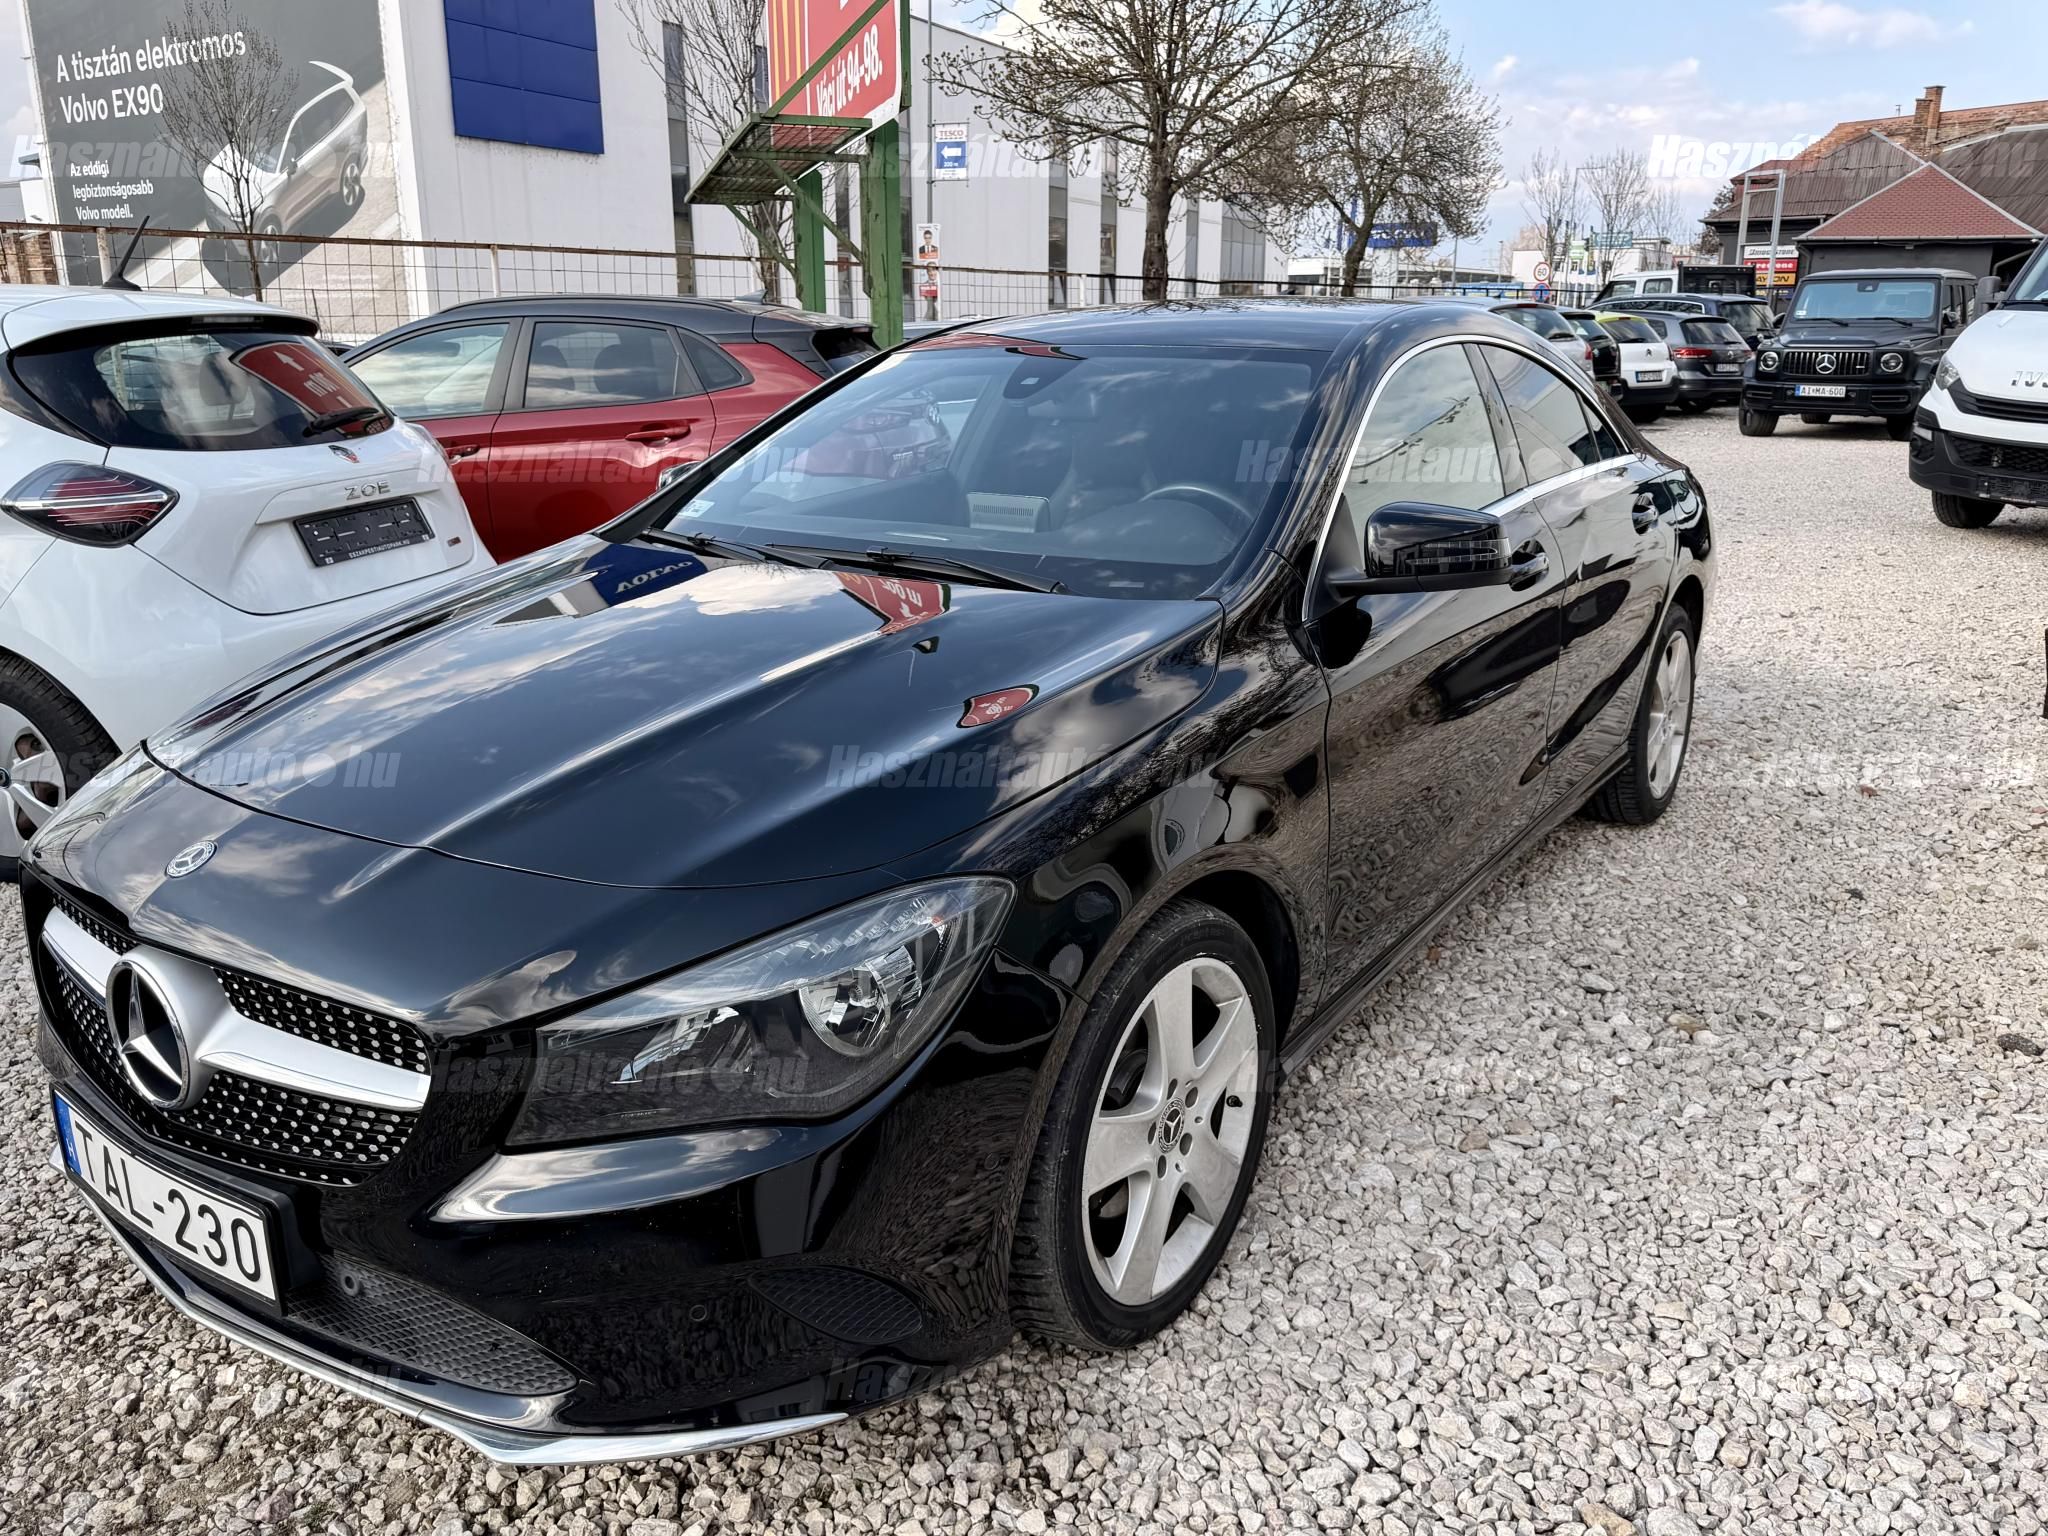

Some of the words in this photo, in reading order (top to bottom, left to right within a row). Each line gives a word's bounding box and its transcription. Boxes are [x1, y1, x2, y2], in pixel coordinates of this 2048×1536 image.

[57, 54, 70, 83] A
[71, 44, 132, 81] tisztán
[135, 31, 247, 72] elektromos
[816, 64, 836, 117] Váci
[836, 56, 846, 112] út
[847, 24, 883, 101] 94-98.
[60, 93, 108, 124] Volvo
[111, 83, 164, 118] EX90
[939, 129, 964, 137] TESCO
[70, 162, 81, 177] Az
[82, 160, 110, 178] eddigi
[72, 179, 154, 202] legbiztonságosabb
[75, 205, 100, 220] Volvo
[101, 203, 134, 219] modell.
[344, 480, 392, 501] ZOE
[74, 1119, 262, 1283] TAL-230
